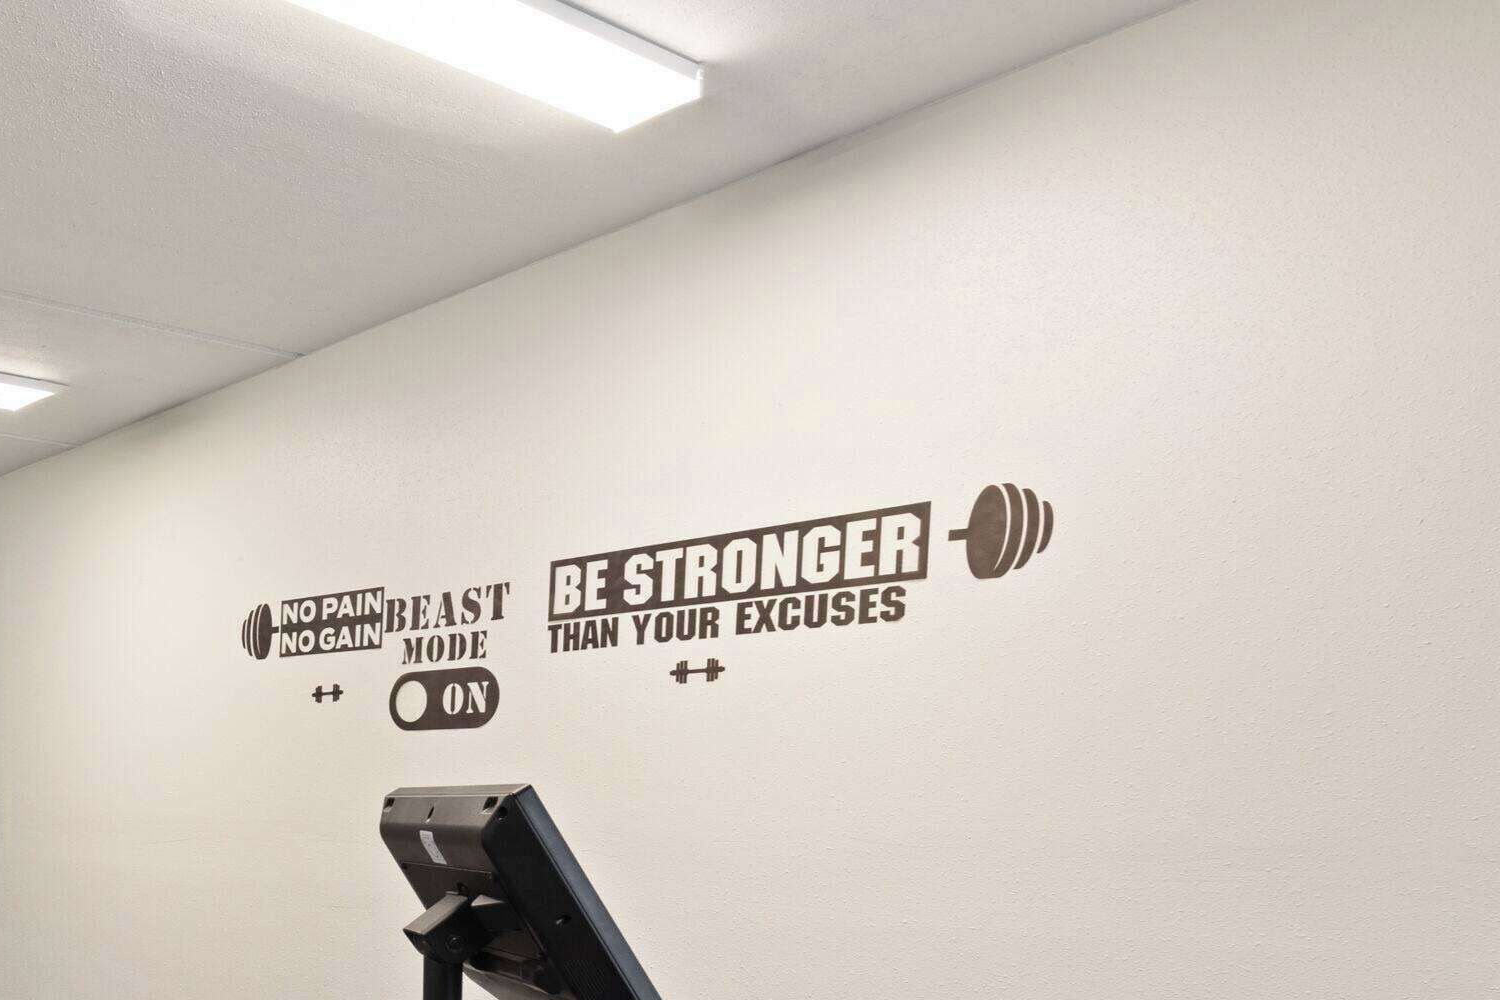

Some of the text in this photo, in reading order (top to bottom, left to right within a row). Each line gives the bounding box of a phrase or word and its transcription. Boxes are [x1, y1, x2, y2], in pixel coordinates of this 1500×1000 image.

[554, 512, 921, 615] BE STRONGER
[282, 590, 382, 625] NO PAIN
[384, 581, 510, 633] BEAST
[548, 585, 906, 654] THAN YOUR EXCUSES
[281, 622, 381, 654] NO GAIN
[402, 630, 488, 665] MODE
[442, 681, 490, 715] ON
